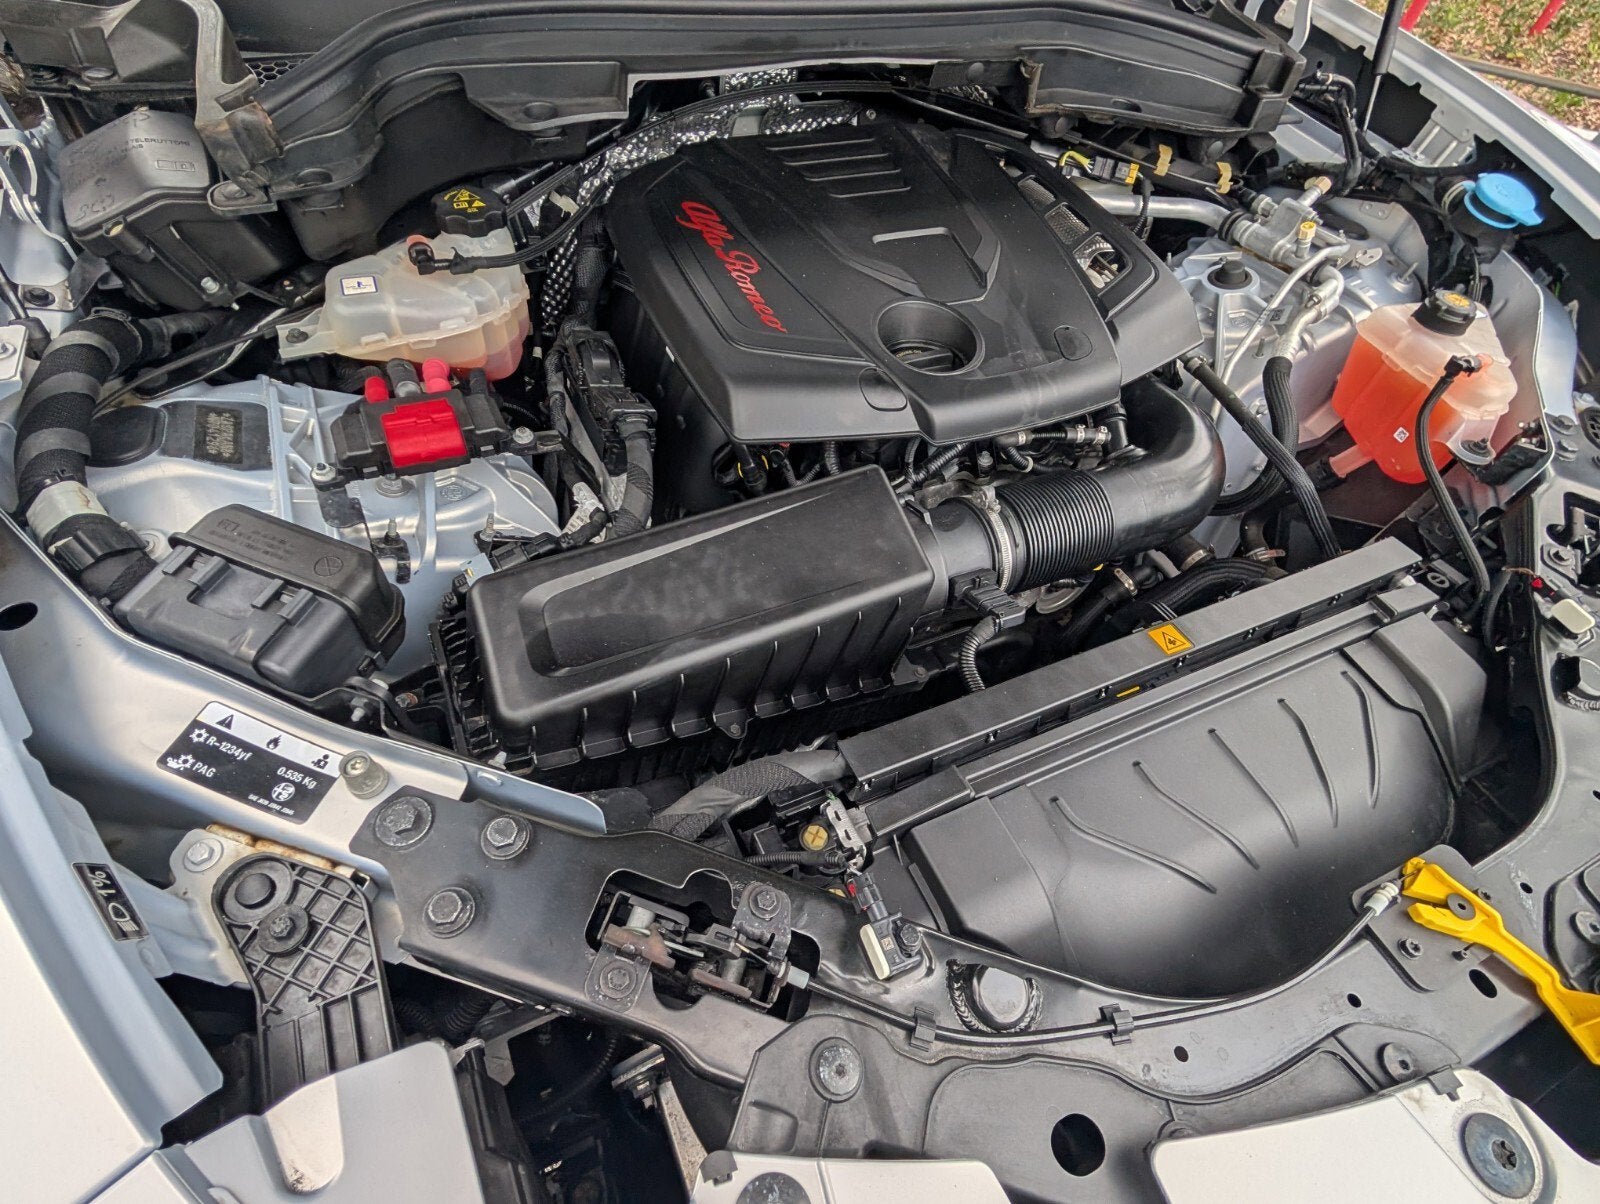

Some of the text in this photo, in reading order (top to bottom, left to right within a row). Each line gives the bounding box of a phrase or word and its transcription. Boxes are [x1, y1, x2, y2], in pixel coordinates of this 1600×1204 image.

[675, 201, 788, 334] Alfa Romeo
[206, 735, 253, 761] R-1234yf
[192, 762, 217, 778] PAG
[276, 767, 318, 790] 0.535 Kg
[88, 871, 116, 896] 1%
